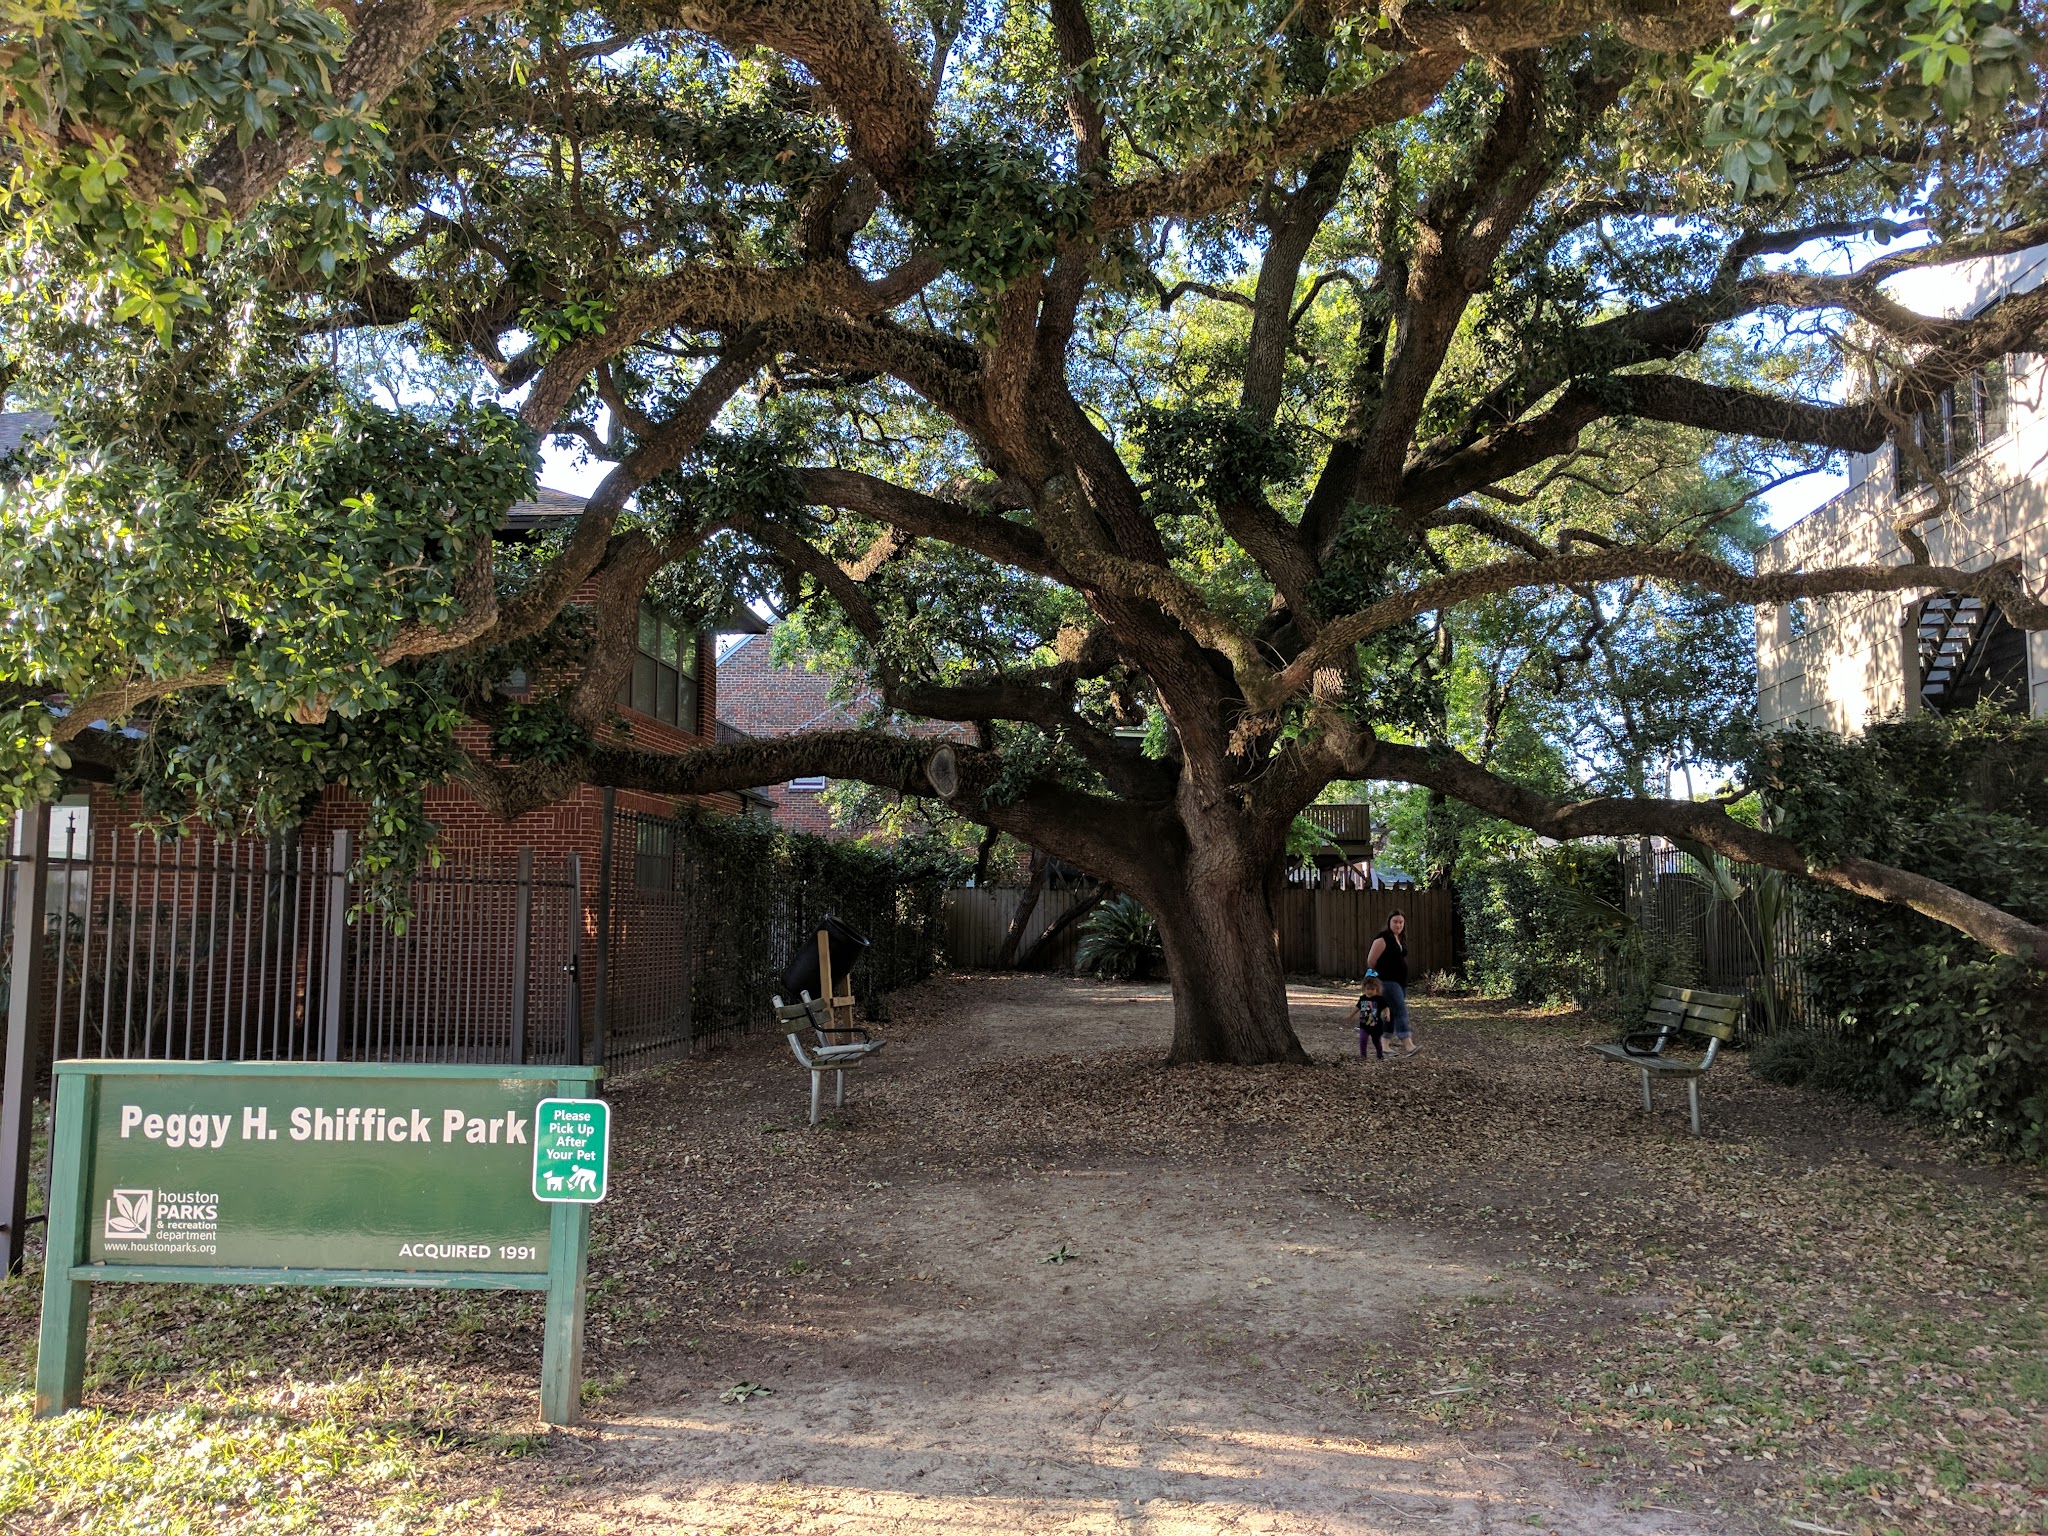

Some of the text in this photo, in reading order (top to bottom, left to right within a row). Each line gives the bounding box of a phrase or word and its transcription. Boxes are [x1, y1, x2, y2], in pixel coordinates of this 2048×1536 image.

[554, 1110, 591, 1121] Please
[120, 1105, 528, 1148] Peggy H. Shiffick Park
[549, 1123, 595, 1137] Pick Up
[556, 1136, 587, 1147] After
[546, 1149, 596, 1161] Your Pet
[157, 1189, 219, 1204] houston
[157, 1205, 218, 1219] PARKS
[156, 1220, 217, 1230] & recreation
[156, 1230, 216, 1241] department
[104, 1242, 216, 1254] www.houstonparks.org
[398, 1243, 536, 1260] ACQUIRED 1991
